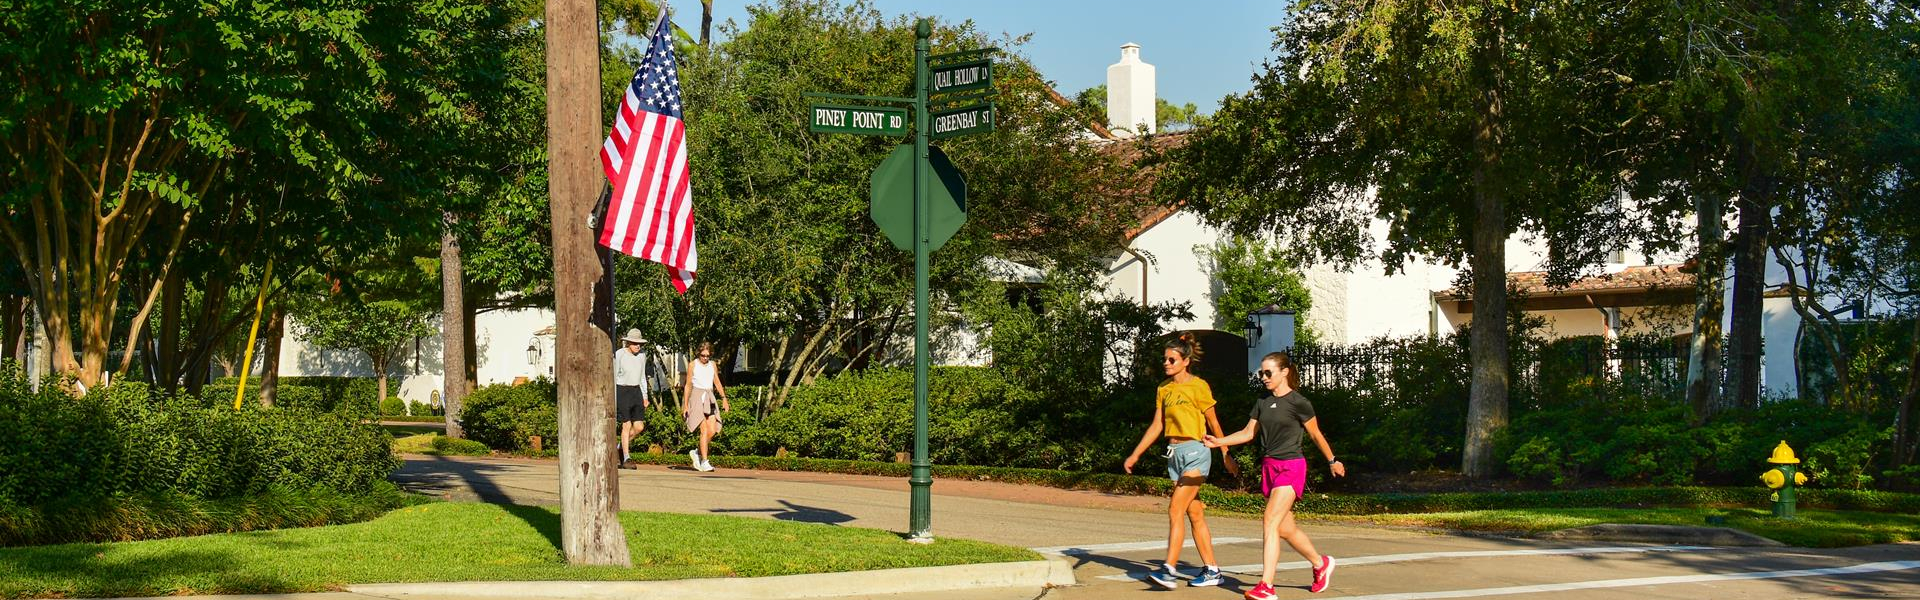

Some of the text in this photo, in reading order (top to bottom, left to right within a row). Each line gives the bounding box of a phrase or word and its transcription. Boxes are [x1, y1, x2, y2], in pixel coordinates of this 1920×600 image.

[935, 67, 988, 91] QUAIL HOLLOW LN
[815, 108, 902, 129] PINEY POINT RD
[935, 110, 990, 133] GREENBAY ST
